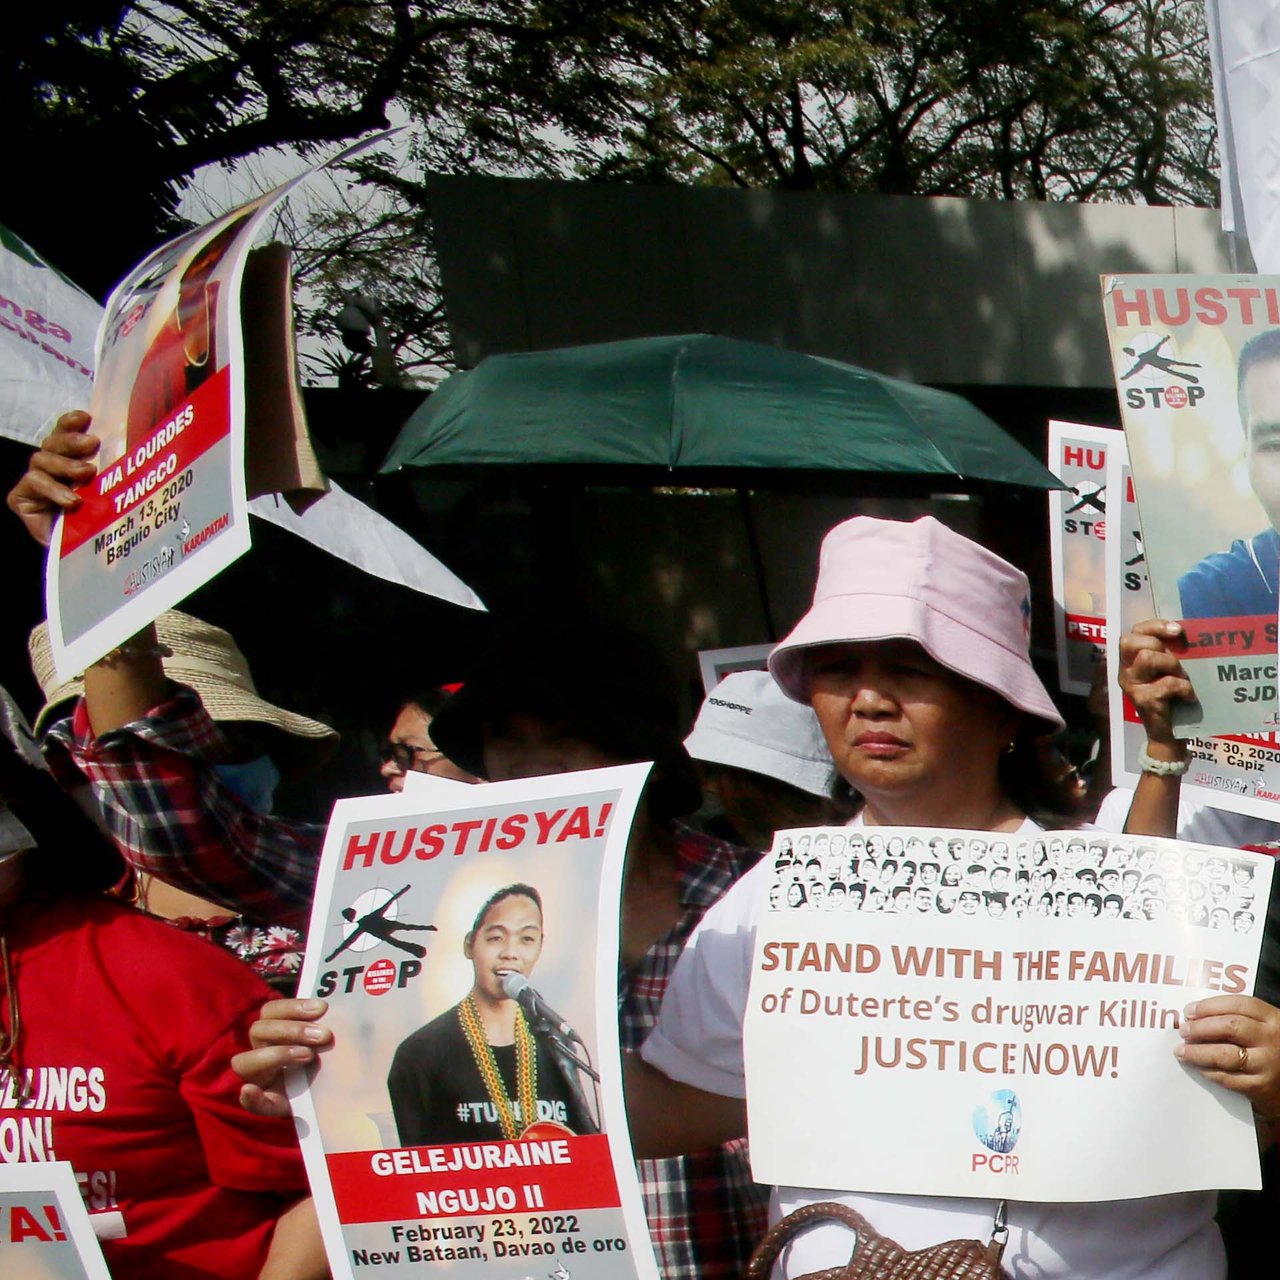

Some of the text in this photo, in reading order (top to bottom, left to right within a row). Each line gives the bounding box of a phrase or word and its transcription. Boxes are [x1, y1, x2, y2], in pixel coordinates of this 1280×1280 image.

[100, 404, 194, 495] MA LOURDES
[114, 453, 177, 514] TANGCO
[95, 469, 193, 555] March 13, 2020
[107, 502, 181, 565] Baguio City
[183, 513, 229, 555] KARAPATAN
[1183, 628, 1256, 650] Larry
[1217, 664, 1278, 683] Marc
[1233, 686, 1278, 704] SJD
[1223, 742, 1244, 757] 30,
[1227, 755, 1265, 772] Capiz
[342, 802, 613, 870] HUSTISYA!
[761, 941, 881, 974] STAND
[892, 945, 1001, 981] WITH
[1013, 950, 1059, 982] THE
[760, 987, 793, 1015] of
[971, 997, 1090, 1033] drugwar
[855, 1035, 1120, 1079] JUSTICE NOW!
[0, 1067, 106, 1112] LLINGS
[371, 1140, 571, 1176] GELEJURAINE
[971, 1152, 1020, 1175] PCPR
[416, 1185, 544, 1215] NGUJO II
[0, 1205, 67, 1242] A!
[392, 1215, 580, 1243] February 23, 2022
[352, 1237, 627, 1267] New Bataan, Davao de oro
